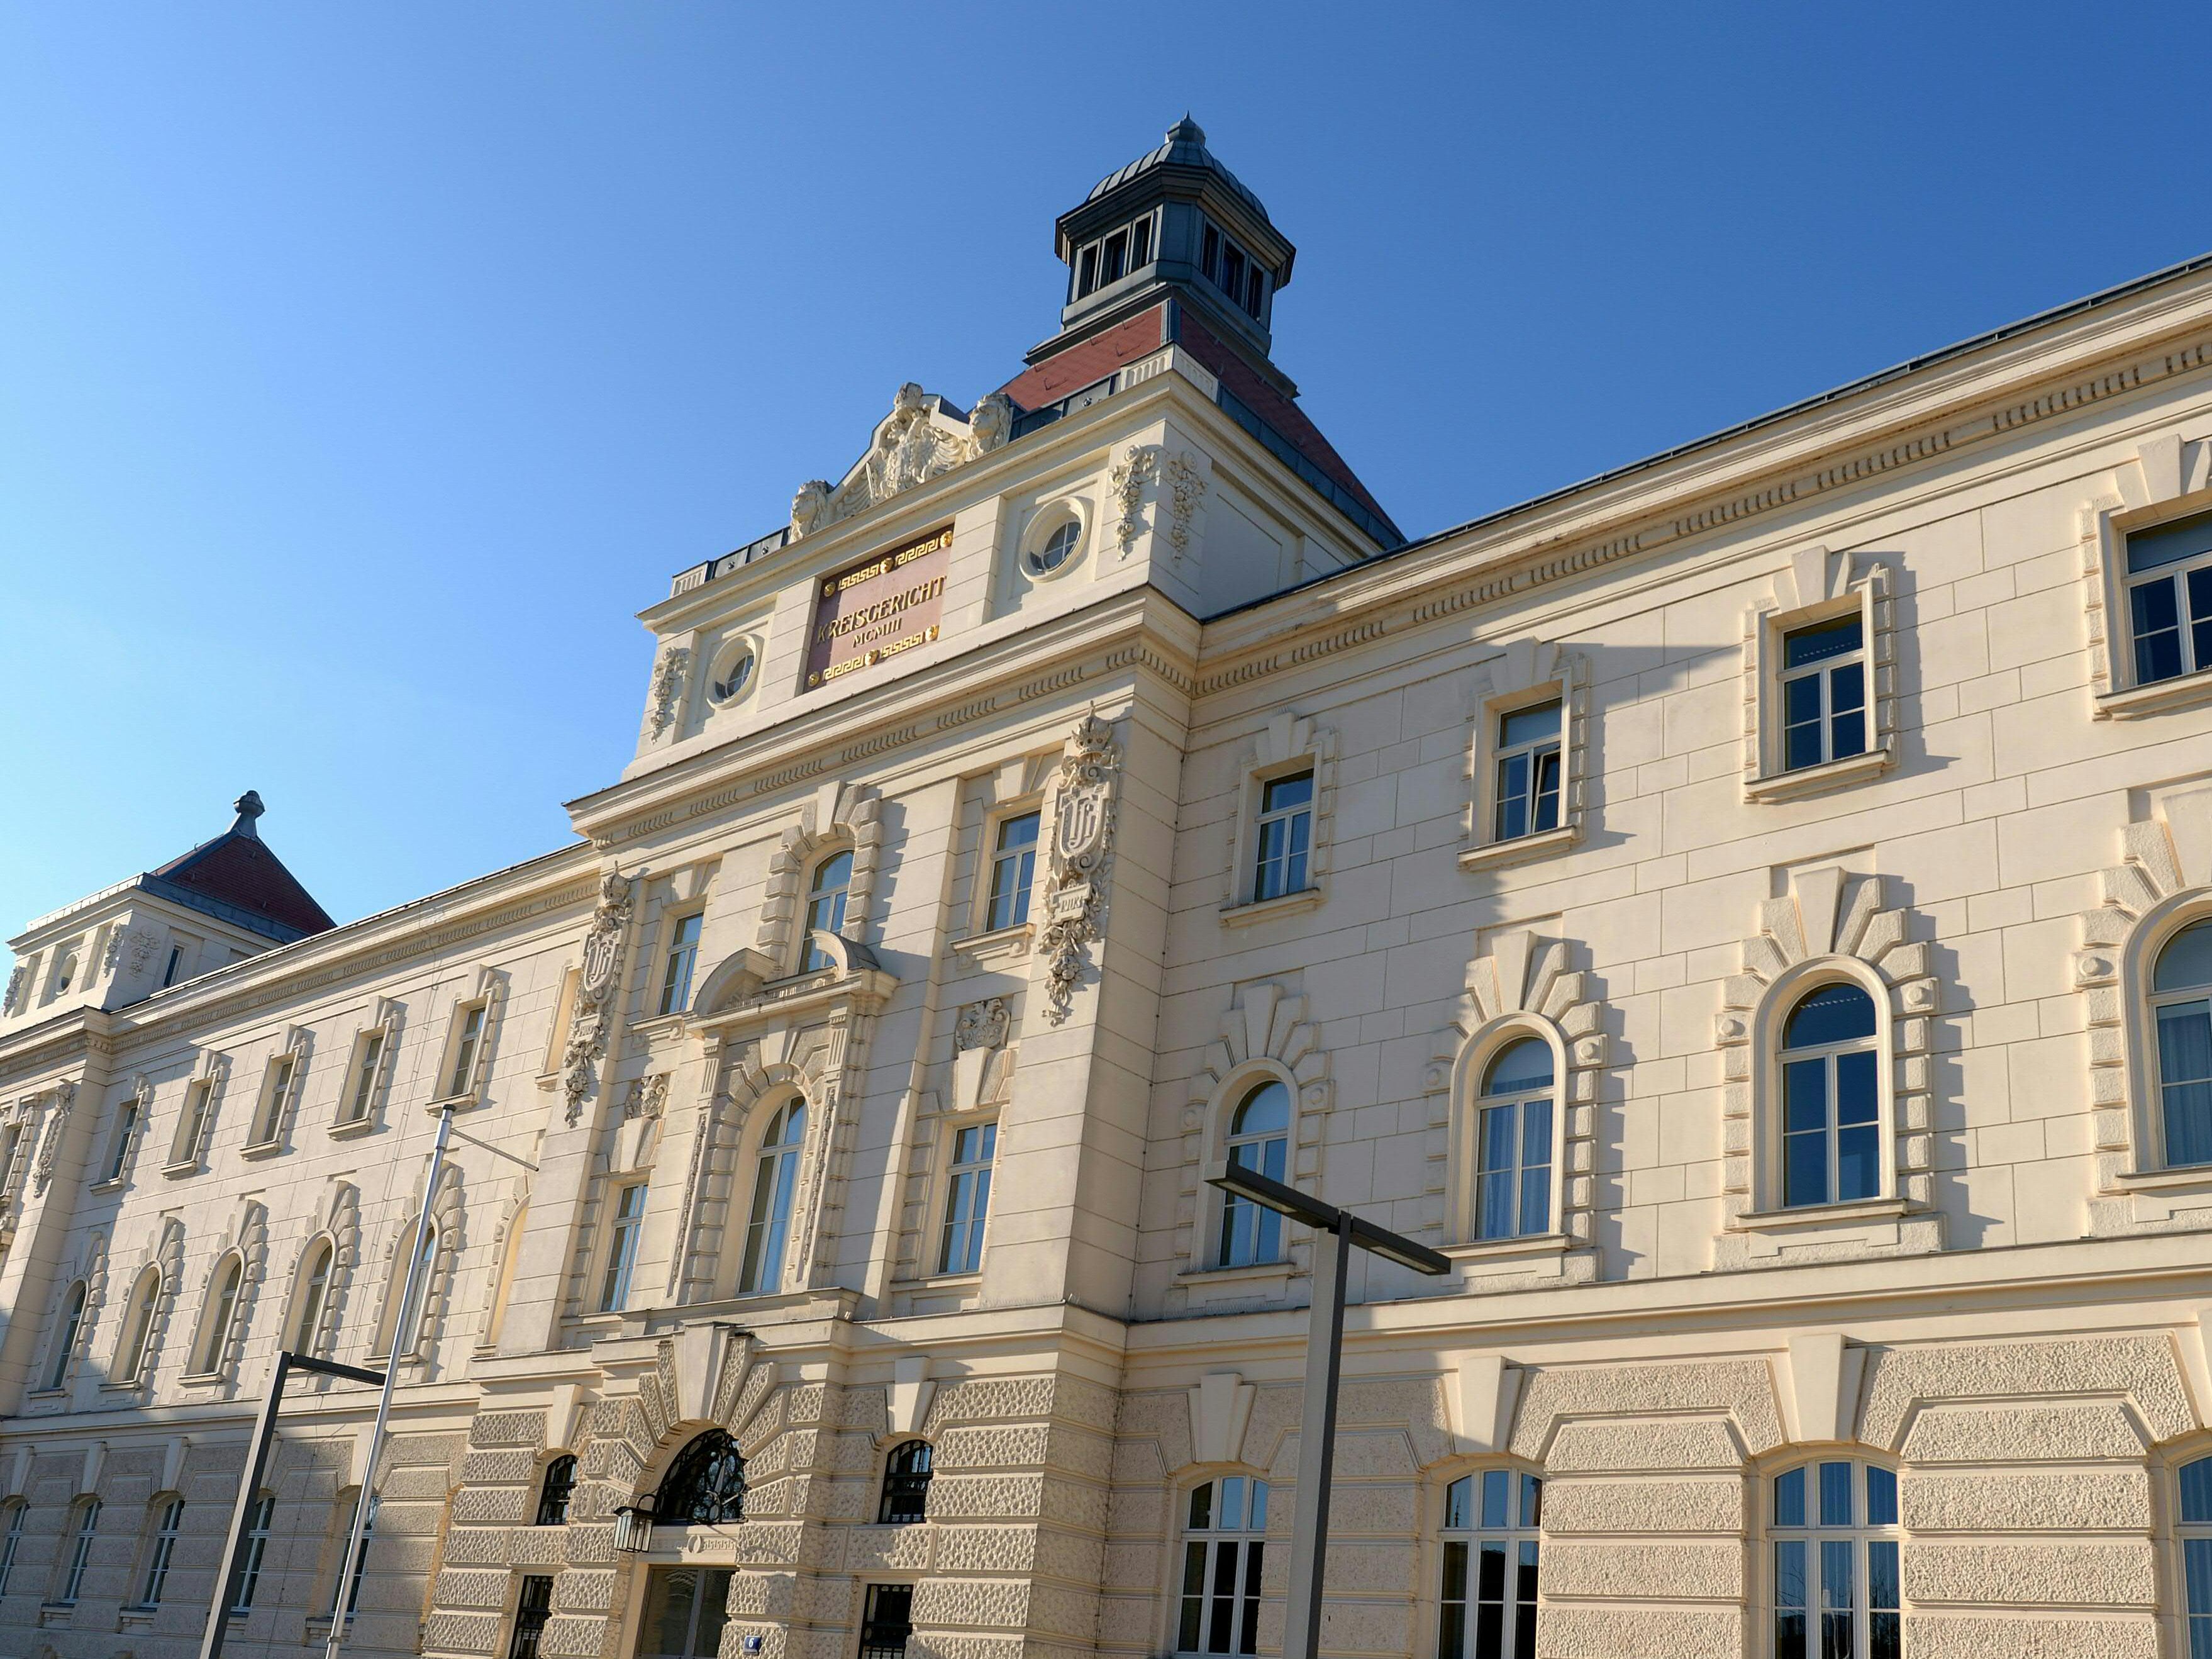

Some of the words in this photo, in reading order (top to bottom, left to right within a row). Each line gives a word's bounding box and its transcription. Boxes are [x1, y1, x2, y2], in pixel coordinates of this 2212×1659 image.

[818, 576, 946, 642] KREISGERICHT
[853, 619, 901, 647] MCMIII
[748, 1638, 754, 1648] 6
